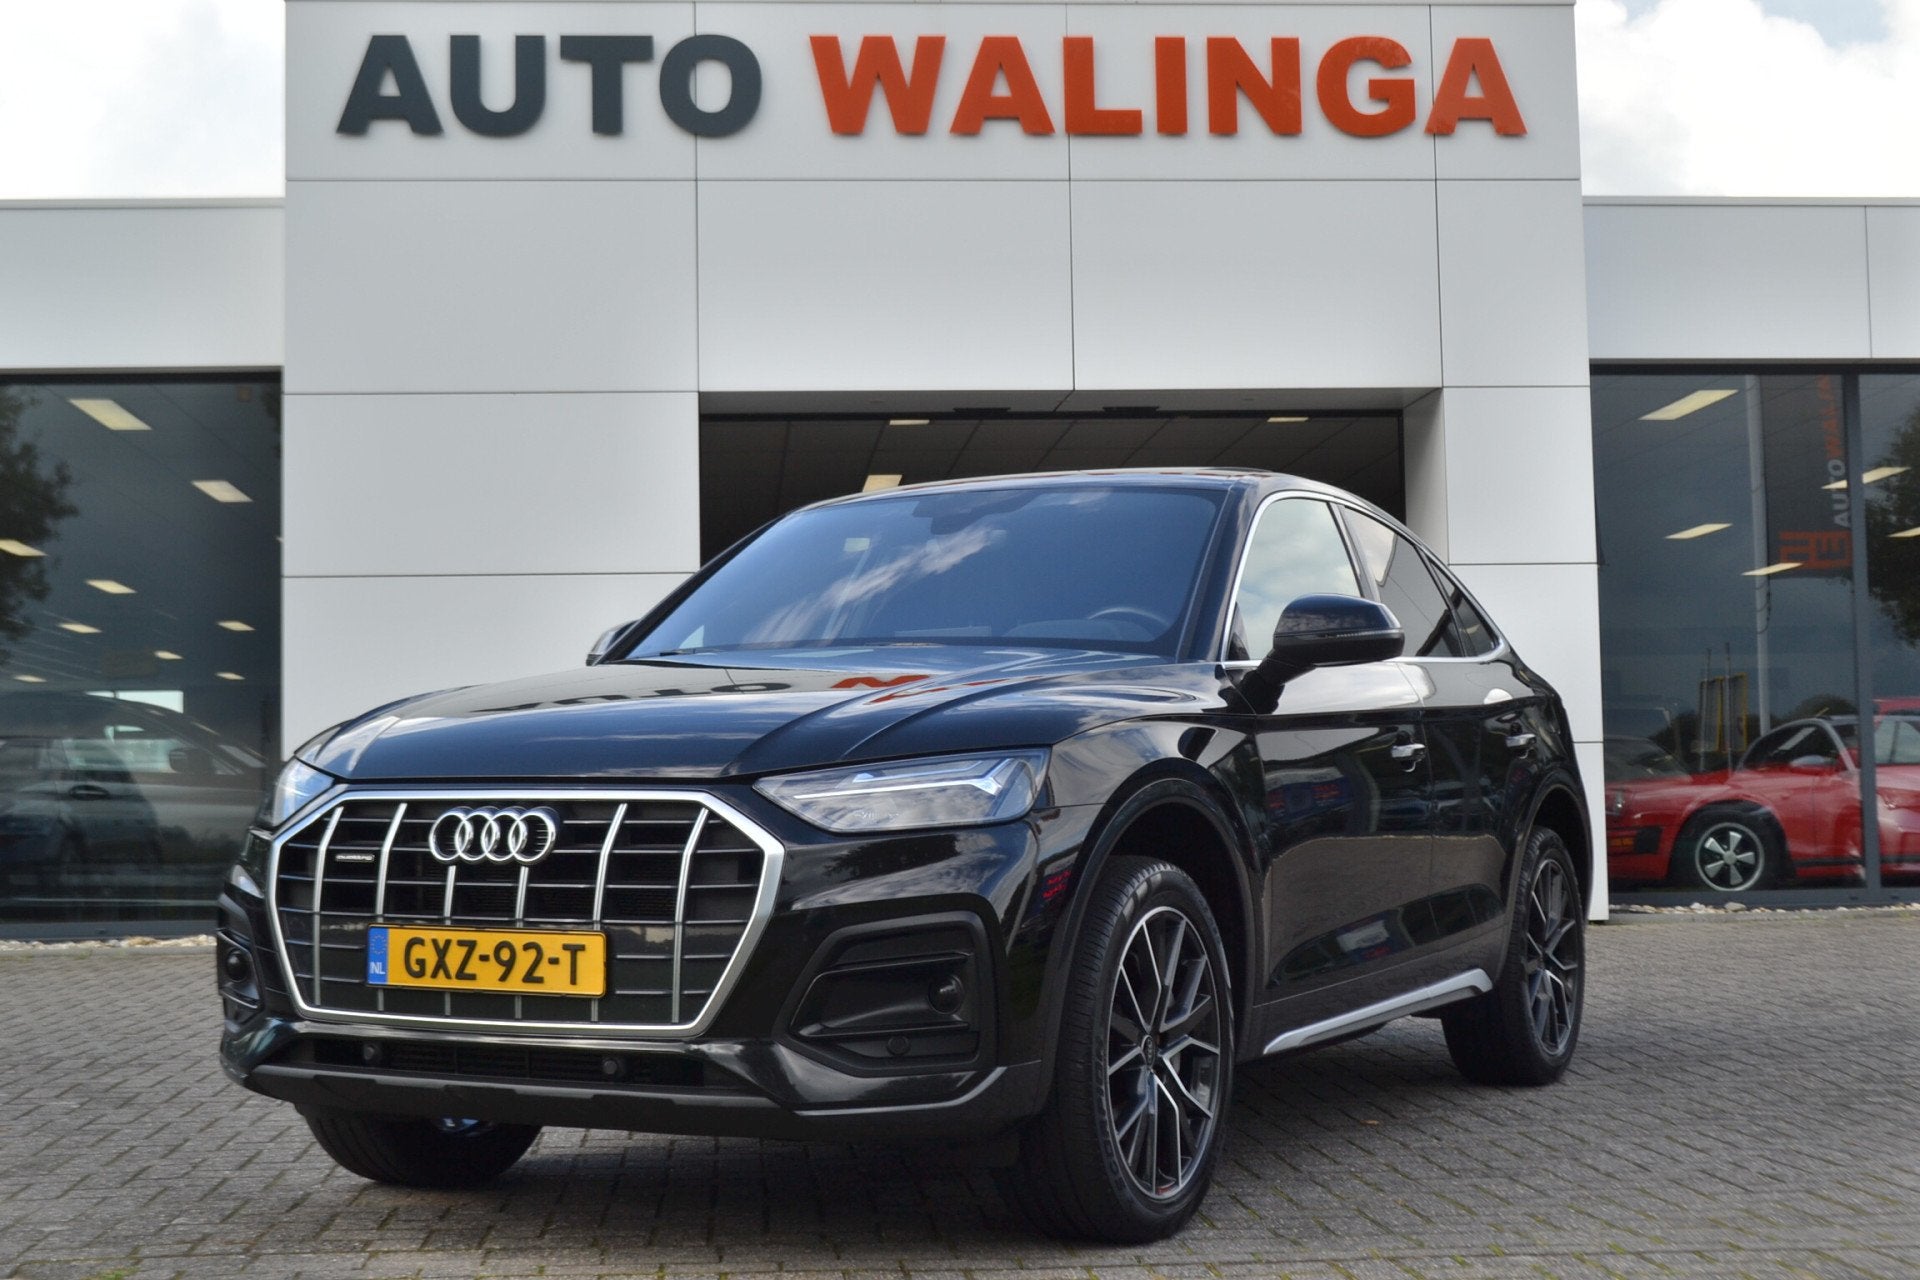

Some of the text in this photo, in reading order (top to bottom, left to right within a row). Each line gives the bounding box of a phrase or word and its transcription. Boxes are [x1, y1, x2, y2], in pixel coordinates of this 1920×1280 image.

[336, 34, 1528, 138] AUTO WALINGA
[1828, 459, 1851, 529] AUO
[369, 961, 386, 975] NL
[404, 937, 586, 985] GXZ-92-T
